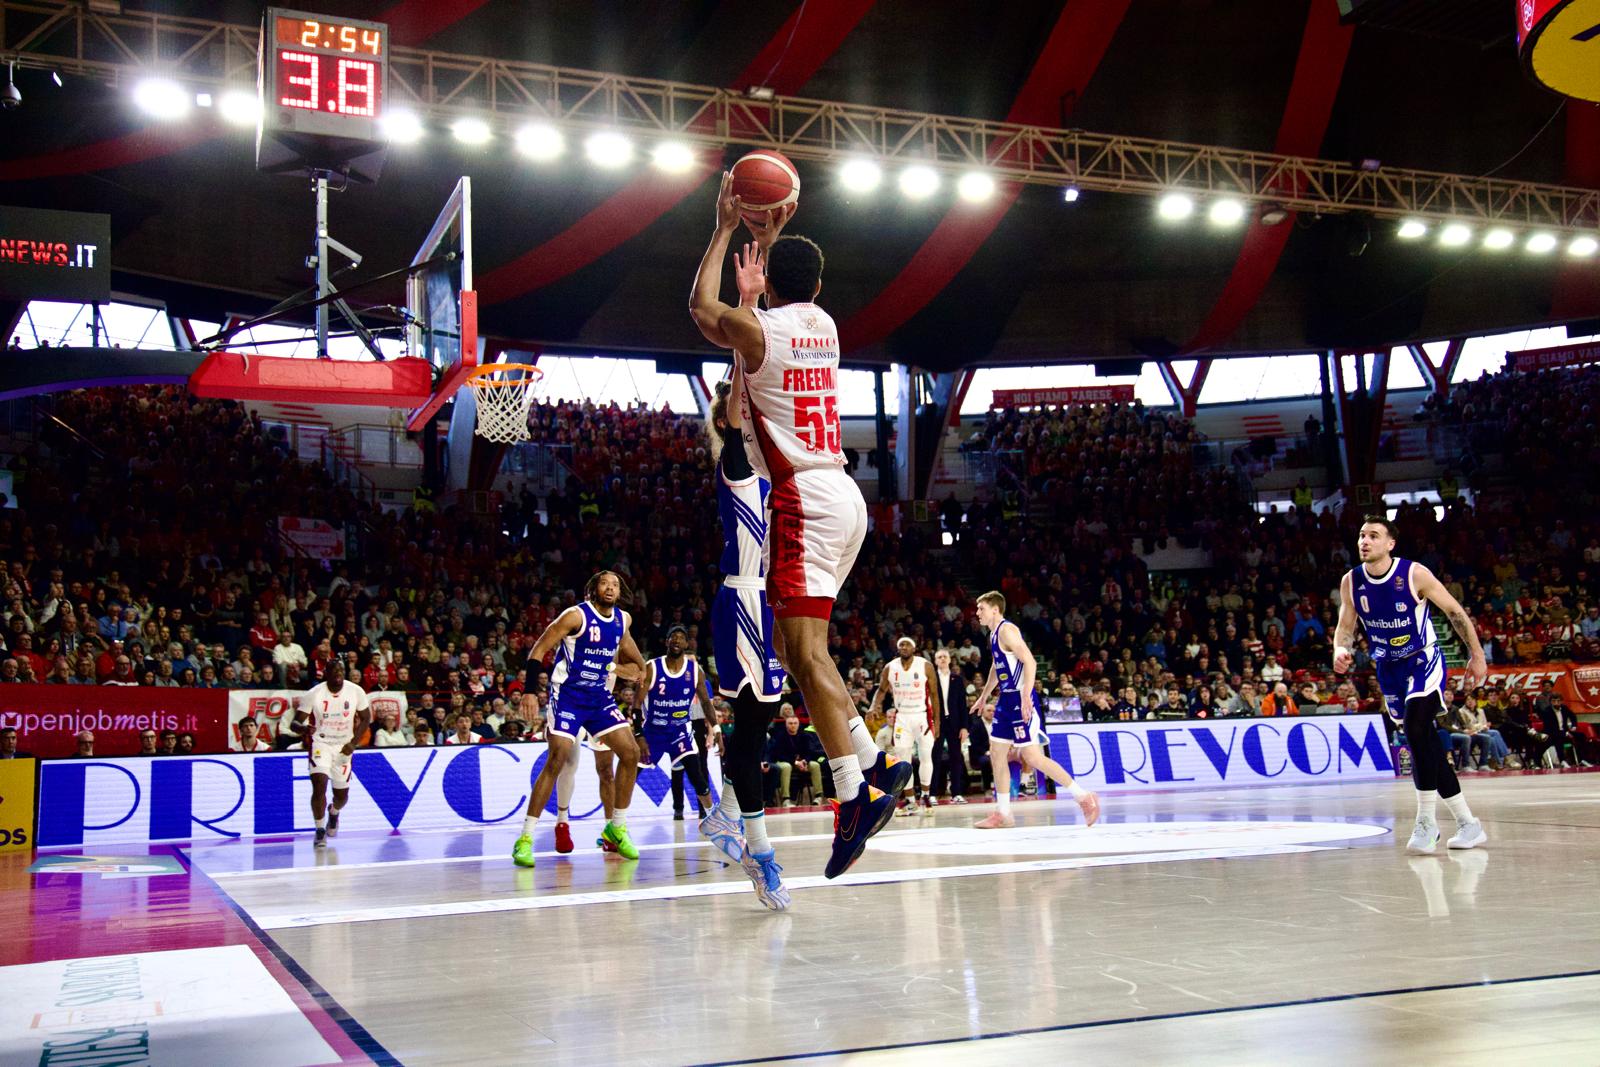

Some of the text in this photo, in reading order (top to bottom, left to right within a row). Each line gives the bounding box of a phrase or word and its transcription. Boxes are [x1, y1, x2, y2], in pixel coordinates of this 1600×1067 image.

[301, 20, 380, 55] 2:54
[282, 51, 375, 117] 3.8
[1034, 389, 1069, 403] SIAMO
[1071, 387, 1113, 401] VARESE
[793, 395, 842, 454] 55
[1360, 595, 1370, 614] 0
[588, 625, 601, 643] 13
[658, 683, 666, 695] 2
[323, 700, 329, 713] 7
[1048, 719, 1394, 787] PREVCOM
[341, 764, 348, 775] 7
